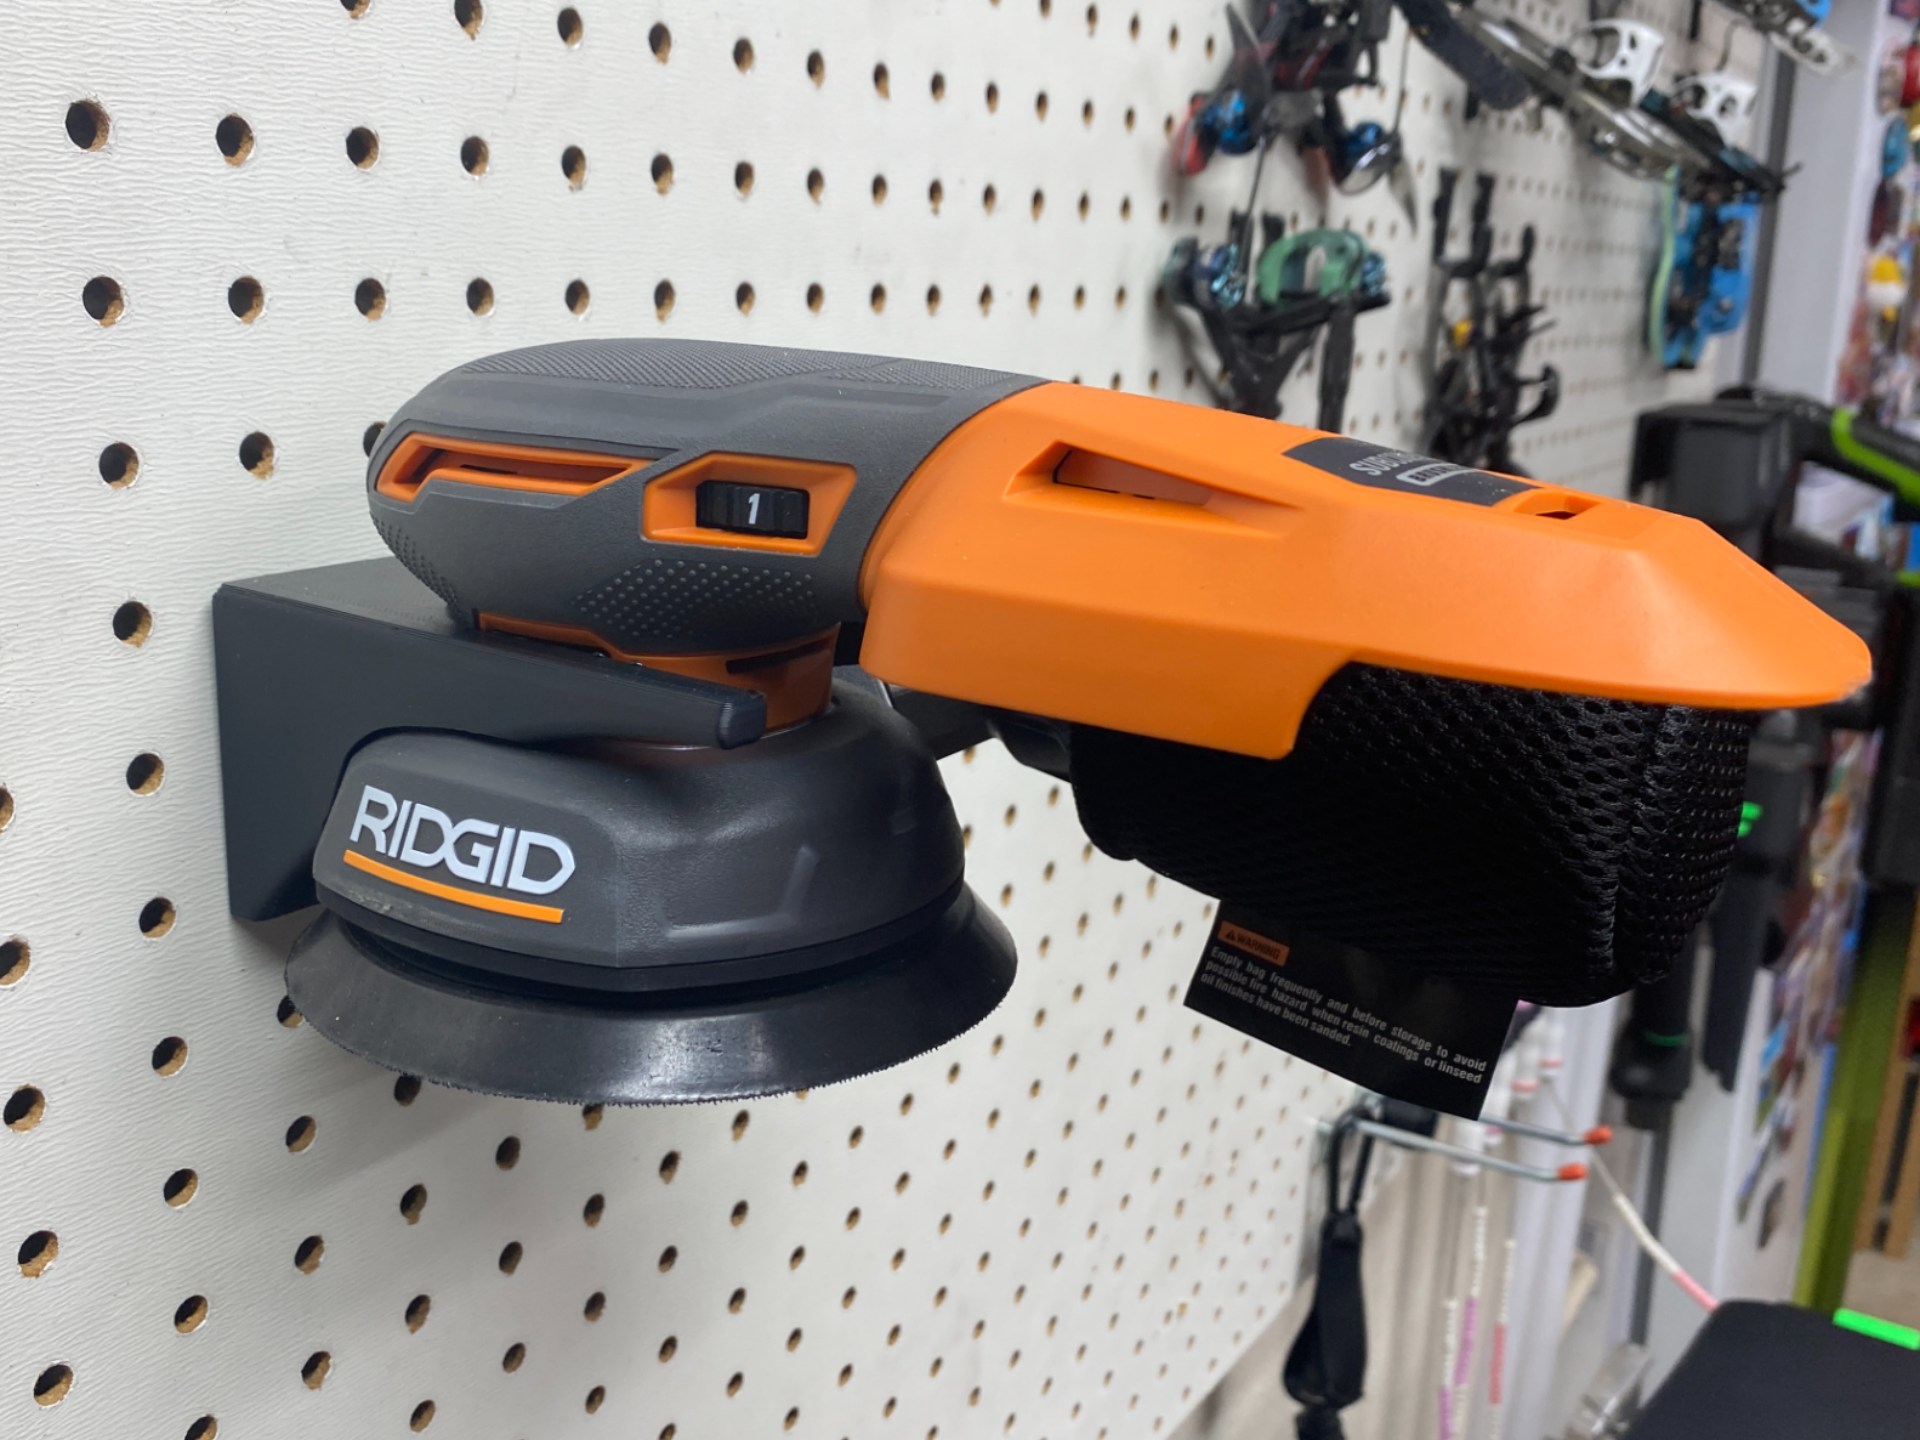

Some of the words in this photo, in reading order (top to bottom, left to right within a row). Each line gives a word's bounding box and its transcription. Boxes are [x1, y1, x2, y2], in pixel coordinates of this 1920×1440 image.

[748, 493, 760, 525] 1
[349, 785, 576, 895] RIDGID
[1237, 934, 1281, 960] WARNING
[1200, 973, 1214, 986] oil
[1215, 977, 1255, 1003] finishes
[1256, 995, 1281, 1016] have
[1282, 1006, 1309, 1028] been
[1310, 1021, 1351, 1047] sanded.
[1205, 961, 1248, 985] possible
[1249, 977, 1268, 993] fire
[1271, 987, 1308, 1011] hazard
[1312, 1006, 1341, 1026] when
[1342, 1019, 1370, 1038] resin
[1374, 1034, 1419, 1061] coatings
[1424, 1056, 1438, 1069] or
[1438, 1061, 1482, 1084] linseed
[1210, 946, 1243, 968] Empty
[1246, 961, 1266, 979] bag
[1269, 971, 1324, 1004] frequently
[1327, 998, 1348, 1014] and
[1352, 1007, 1387, 1031] before
[1391, 1026, 1432, 1051] storage
[1436, 1044, 1449, 1058] to
[1453, 1053, 1488, 1072] avoid
